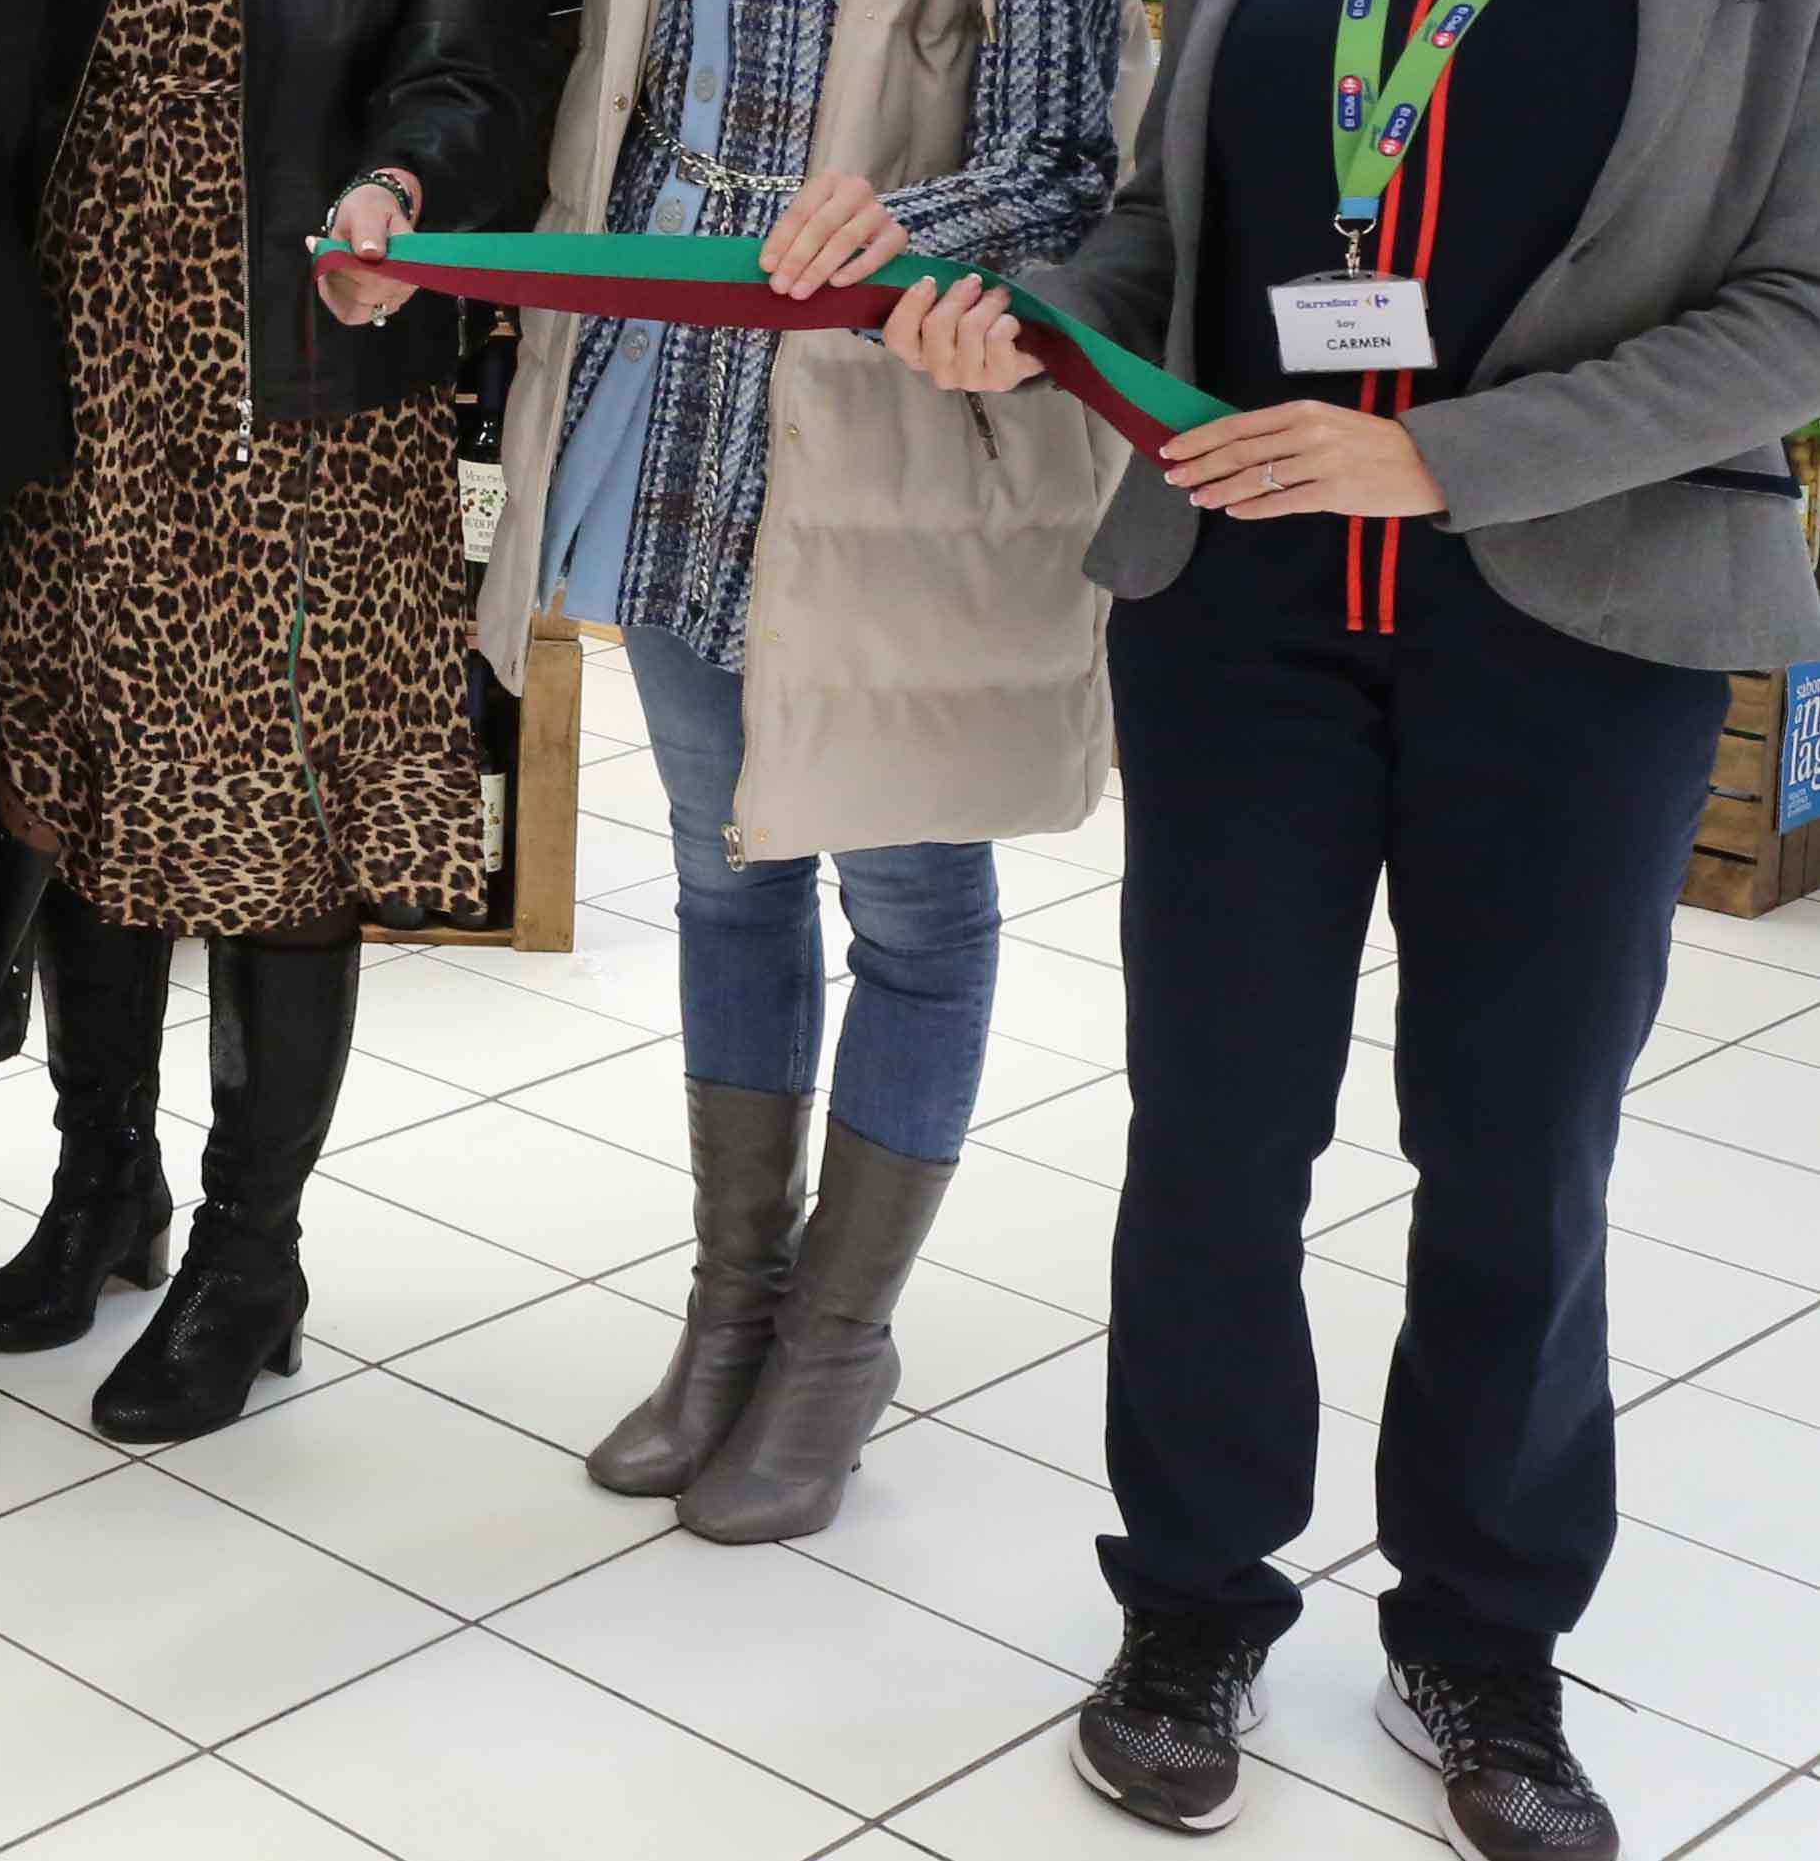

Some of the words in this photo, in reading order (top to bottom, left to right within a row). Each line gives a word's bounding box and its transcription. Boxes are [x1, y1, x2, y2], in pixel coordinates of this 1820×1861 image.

[1297, 298, 1359, 310] Carrefour
[1336, 319, 1356, 329] Soy
[1326, 337, 1392, 350] CARMEN
